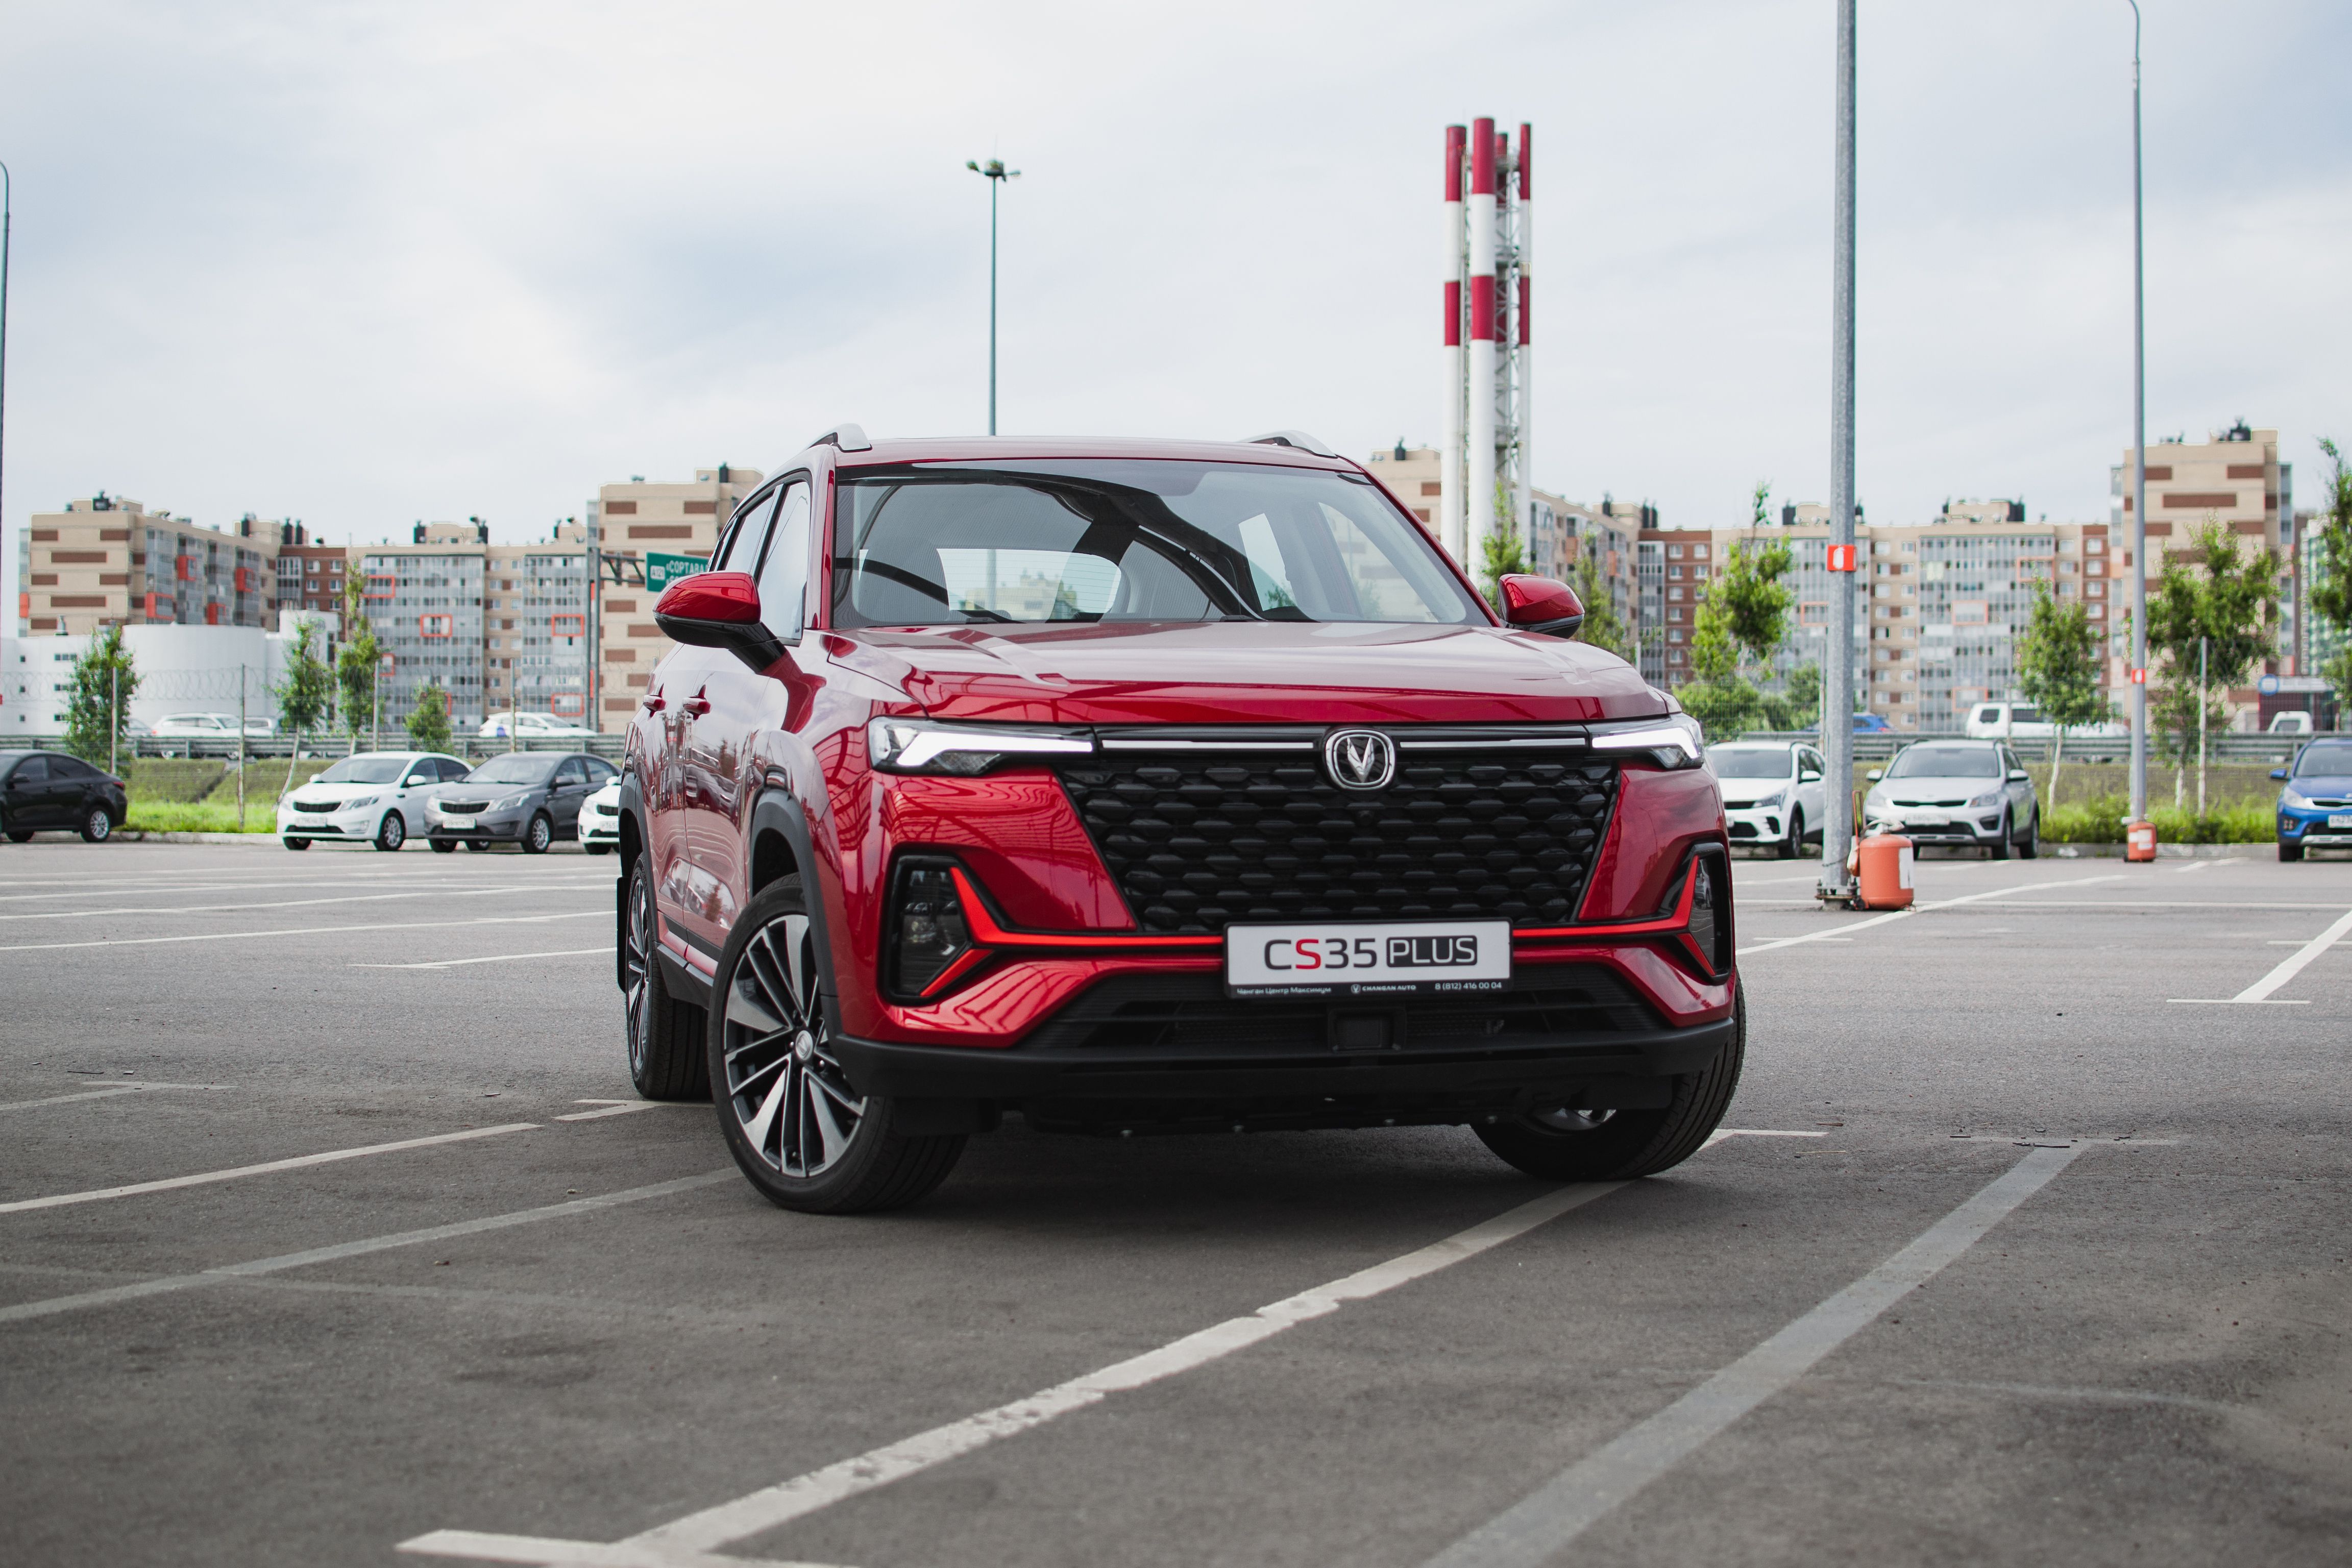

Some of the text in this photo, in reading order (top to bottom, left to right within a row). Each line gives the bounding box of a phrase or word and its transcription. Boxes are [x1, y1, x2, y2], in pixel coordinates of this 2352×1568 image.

[1264, 937, 1475, 970] CS35 PLUS
[1442, 982, 1461, 991] (812)
